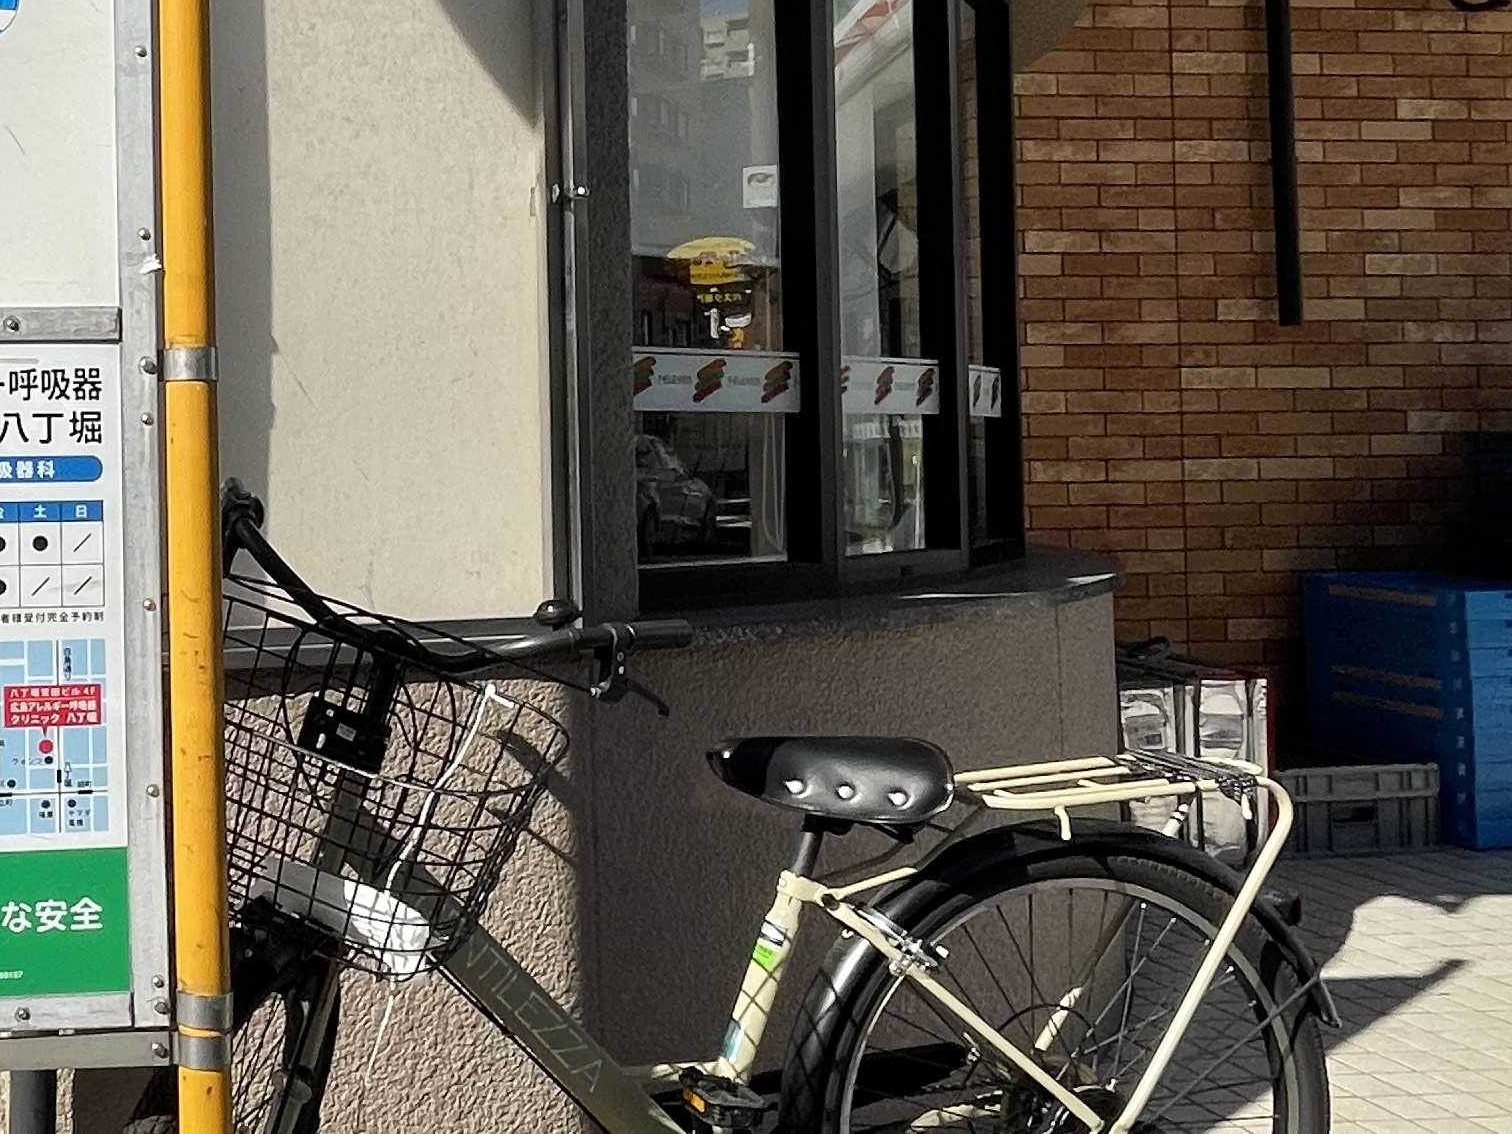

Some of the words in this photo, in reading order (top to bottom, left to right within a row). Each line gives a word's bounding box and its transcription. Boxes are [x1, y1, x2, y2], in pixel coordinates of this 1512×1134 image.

[33, 504, 47, 518] 土
[75, 504, 88, 518] 日
[10, 700, 97, 713] 広島アレルギー呼吸器
[10, 714, 60, 725] クリニック
